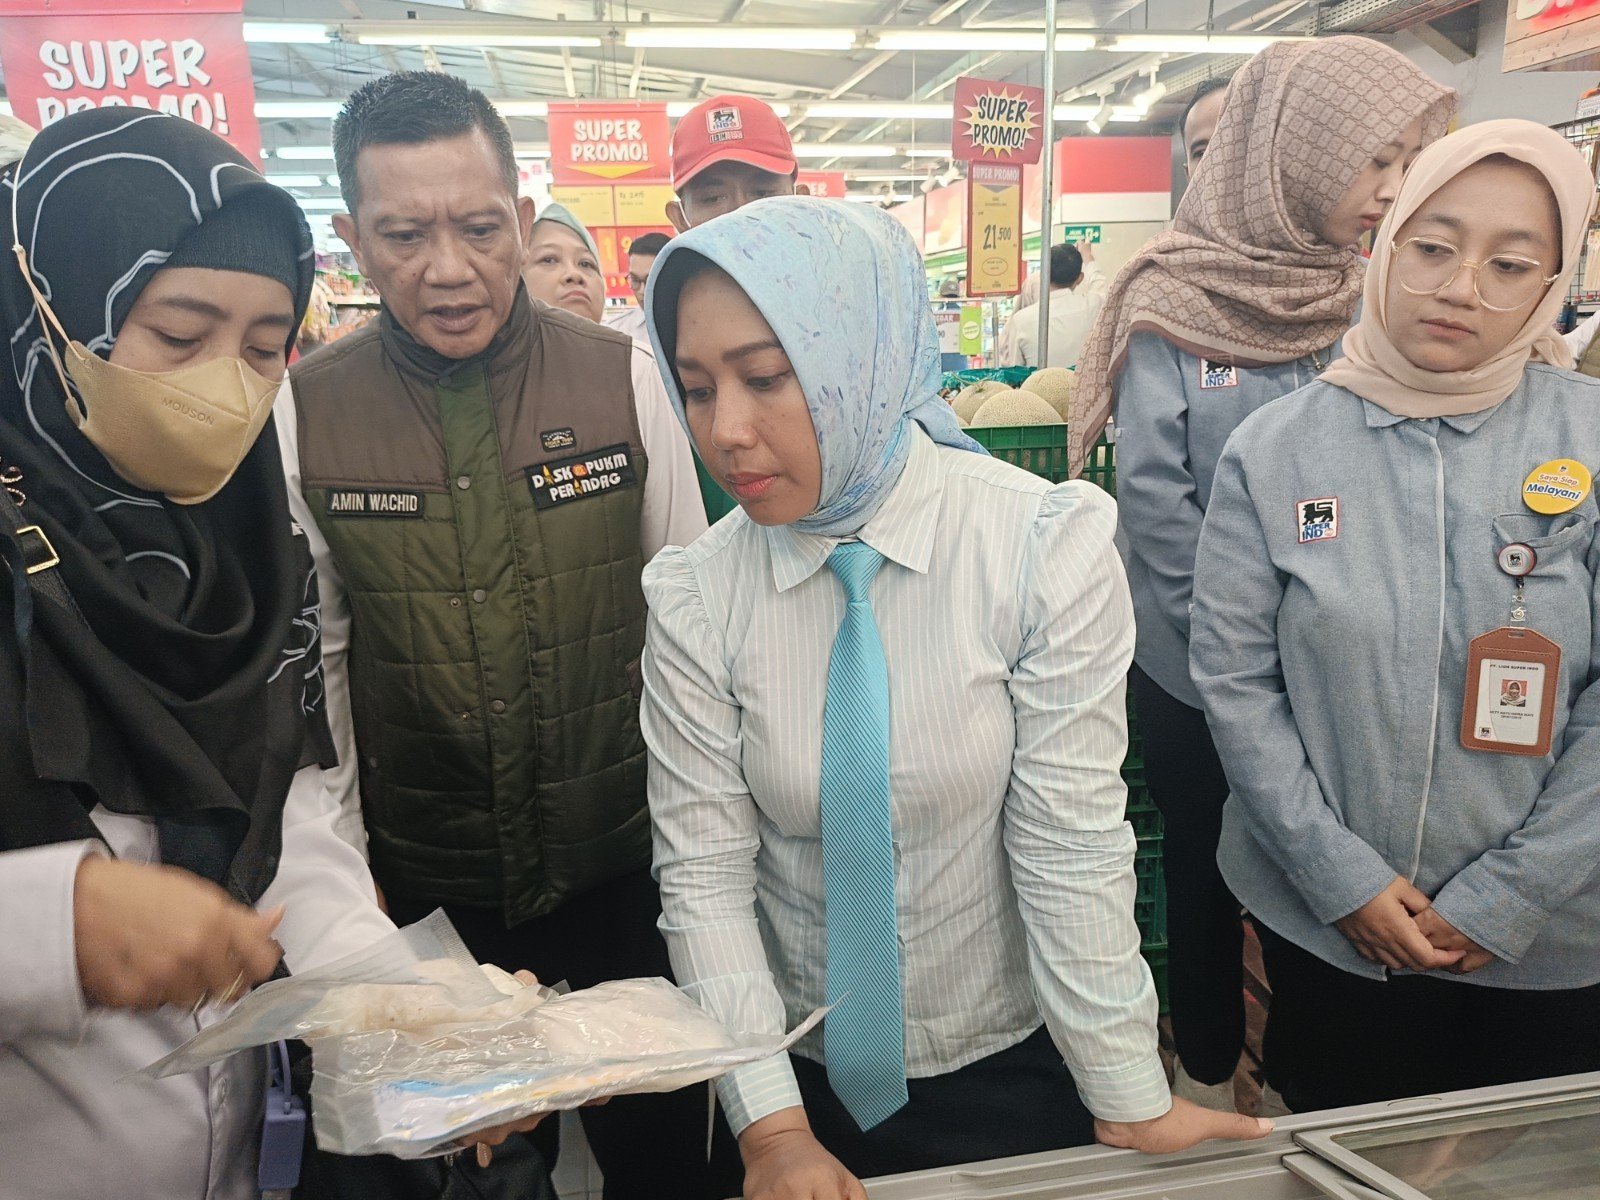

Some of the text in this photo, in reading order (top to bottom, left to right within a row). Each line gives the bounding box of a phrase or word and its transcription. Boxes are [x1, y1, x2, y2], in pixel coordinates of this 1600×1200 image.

[39, 38, 211, 90] SUPER
[978, 96, 1028, 123] SUPER
[573, 119, 642, 141] SUPER
[973, 124, 1026, 148] PROMO!
[571, 142, 648, 161] PROMO!
[161, 398, 215, 425] MOUSON
[1539, 474, 1578, 486] Saya Siap
[331, 492, 418, 512] AMIN WACHID
[1526, 483, 1581, 501] Melayani
